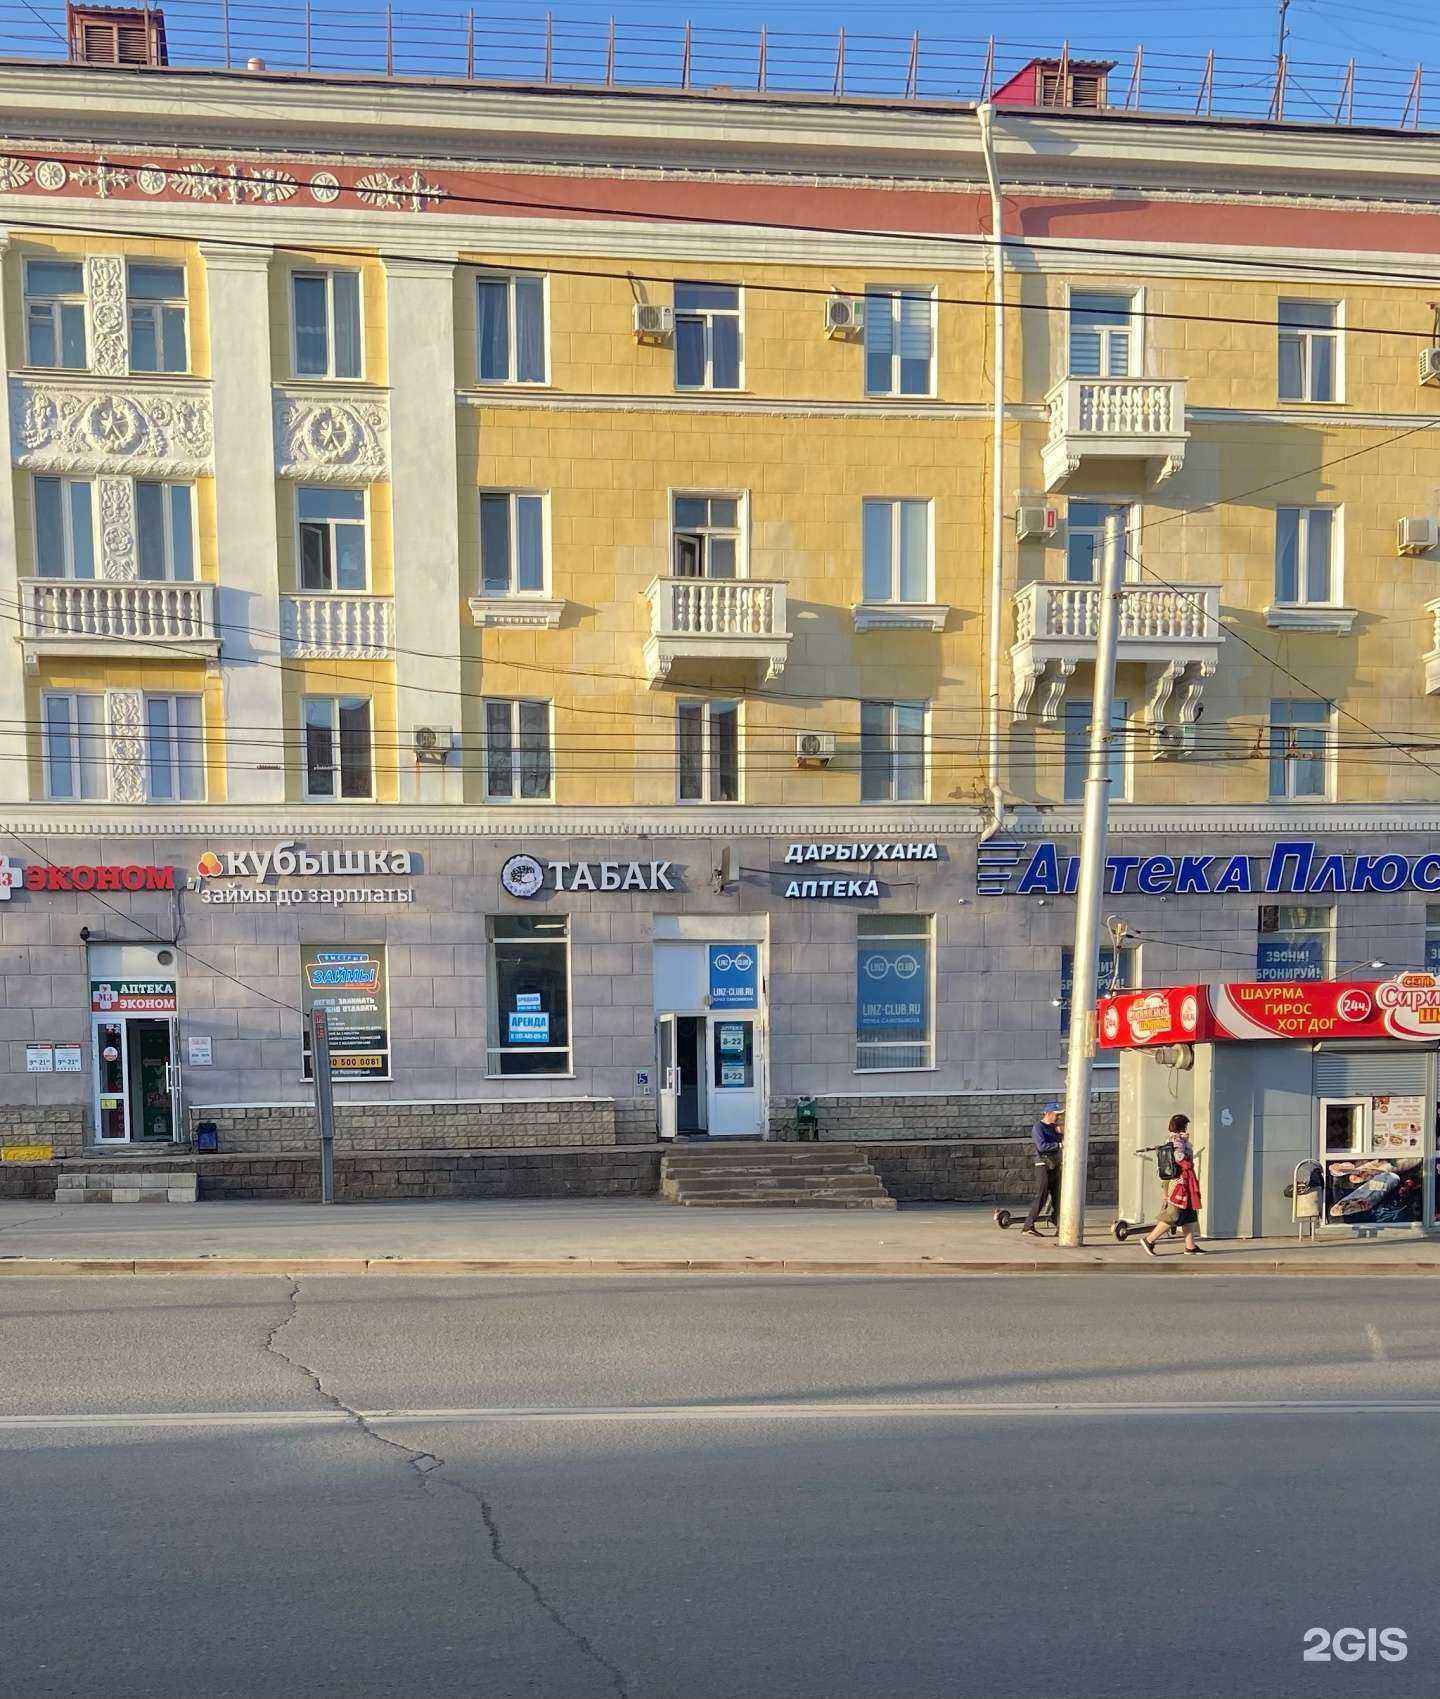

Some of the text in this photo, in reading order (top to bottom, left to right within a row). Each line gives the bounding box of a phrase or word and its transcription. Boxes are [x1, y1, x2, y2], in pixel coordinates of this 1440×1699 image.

[784, 843, 938, 864] ДАРЫУХАНА
[228, 841, 411, 883] кубышка
[26, 865, 175, 891] ЭКОНОМ
[548, 861, 674, 891] ТАБАК
[201, 883, 412, 908] займы до зарплаты
[785, 880, 879, 898] АПТЕКА
[1266, 952, 1309, 962] ЗВОНИ!
[897, 962, 914, 972] CLUB
[1256, 964, 1321, 979] БРОНИРУЙ!
[312, 967, 376, 984] ЗАЙМЫ
[1404, 977, 1435, 987] СЕТЬ
[120, 984, 174, 994] АПТЕКА
[1241, 988, 1304, 1000] ШАУРМА
[120, 999, 175, 1009] ЭКОНОМ
[863, 1003, 920, 1016] LINZ-CLUB.RU
[1265, 1003, 1312, 1015] ГИРОС
[512, 1017, 546, 1028] АРЕНДА
[1278, 1017, 1338, 1032] ХОТ ДОГ
